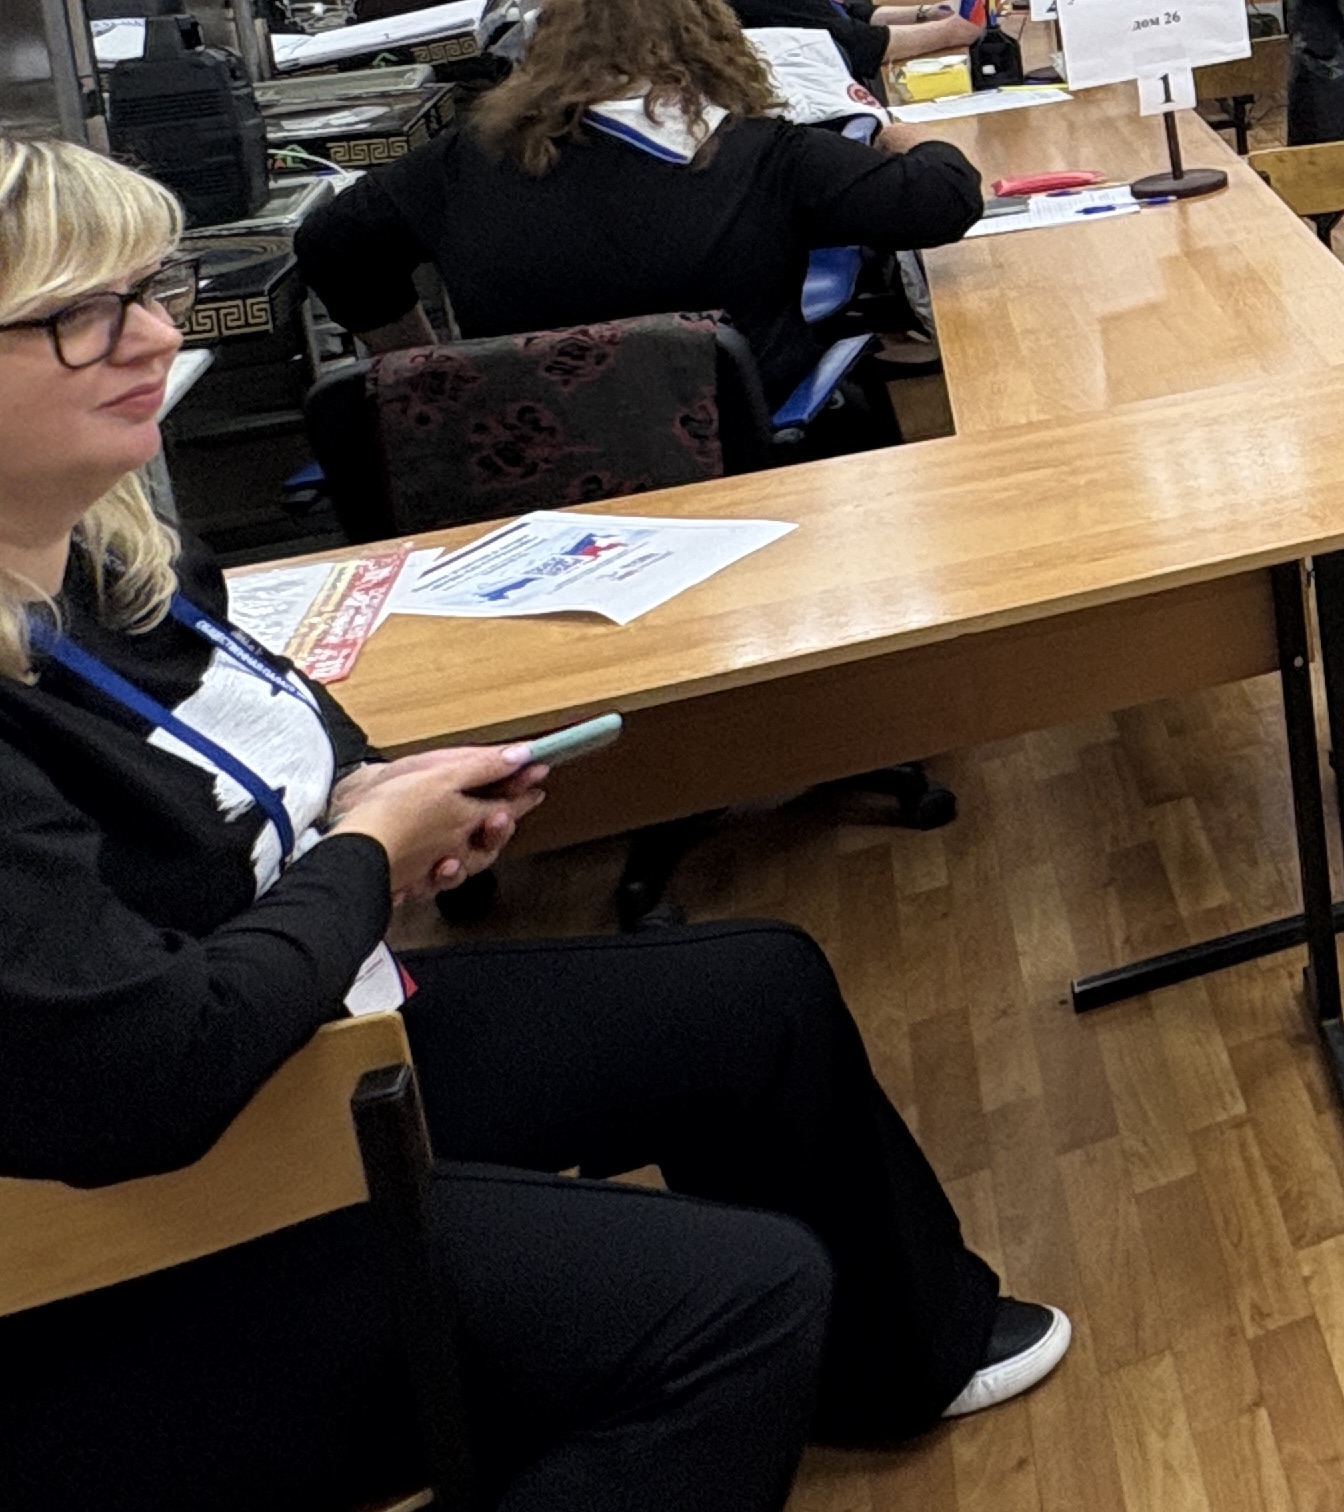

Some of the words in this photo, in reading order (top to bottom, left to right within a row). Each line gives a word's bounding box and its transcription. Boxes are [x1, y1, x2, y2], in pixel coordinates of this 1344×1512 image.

[1132, 16, 1160, 31] дом
[1164, 10, 1181, 25] 26
[1157, 73, 1175, 105] 1
